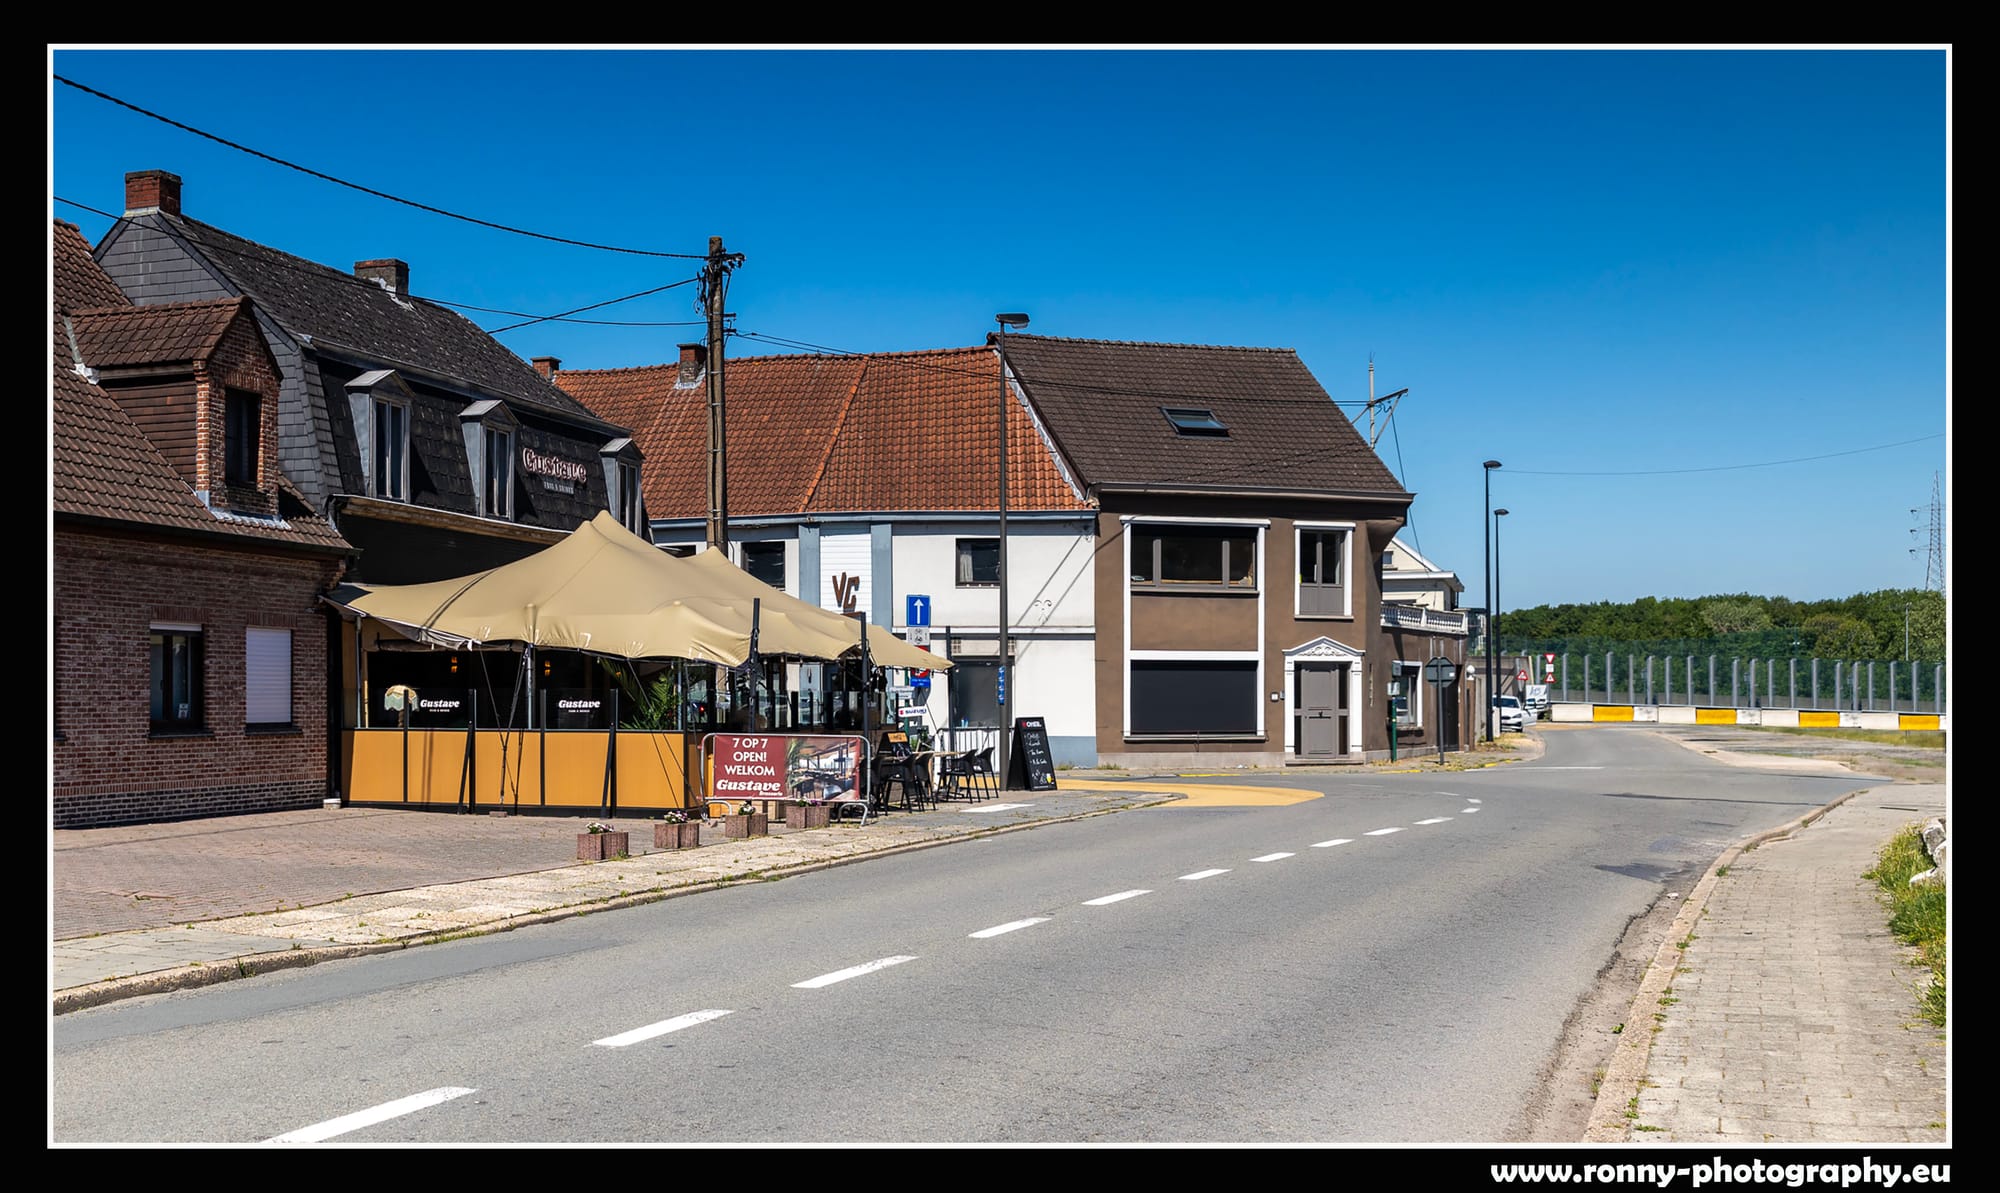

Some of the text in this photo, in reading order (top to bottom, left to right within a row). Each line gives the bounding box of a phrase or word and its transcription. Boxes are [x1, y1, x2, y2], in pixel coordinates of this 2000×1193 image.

[523, 447, 587, 483] Gustave
[420, 699, 460, 708] Gustave
[558, 700, 601, 709] Gustave
[732, 738, 768, 749] 7 OP 7
[733, 751, 767, 762] OPEN!
[724, 764, 775, 776] WELKOM
[716, 779, 781, 791] Gustave
